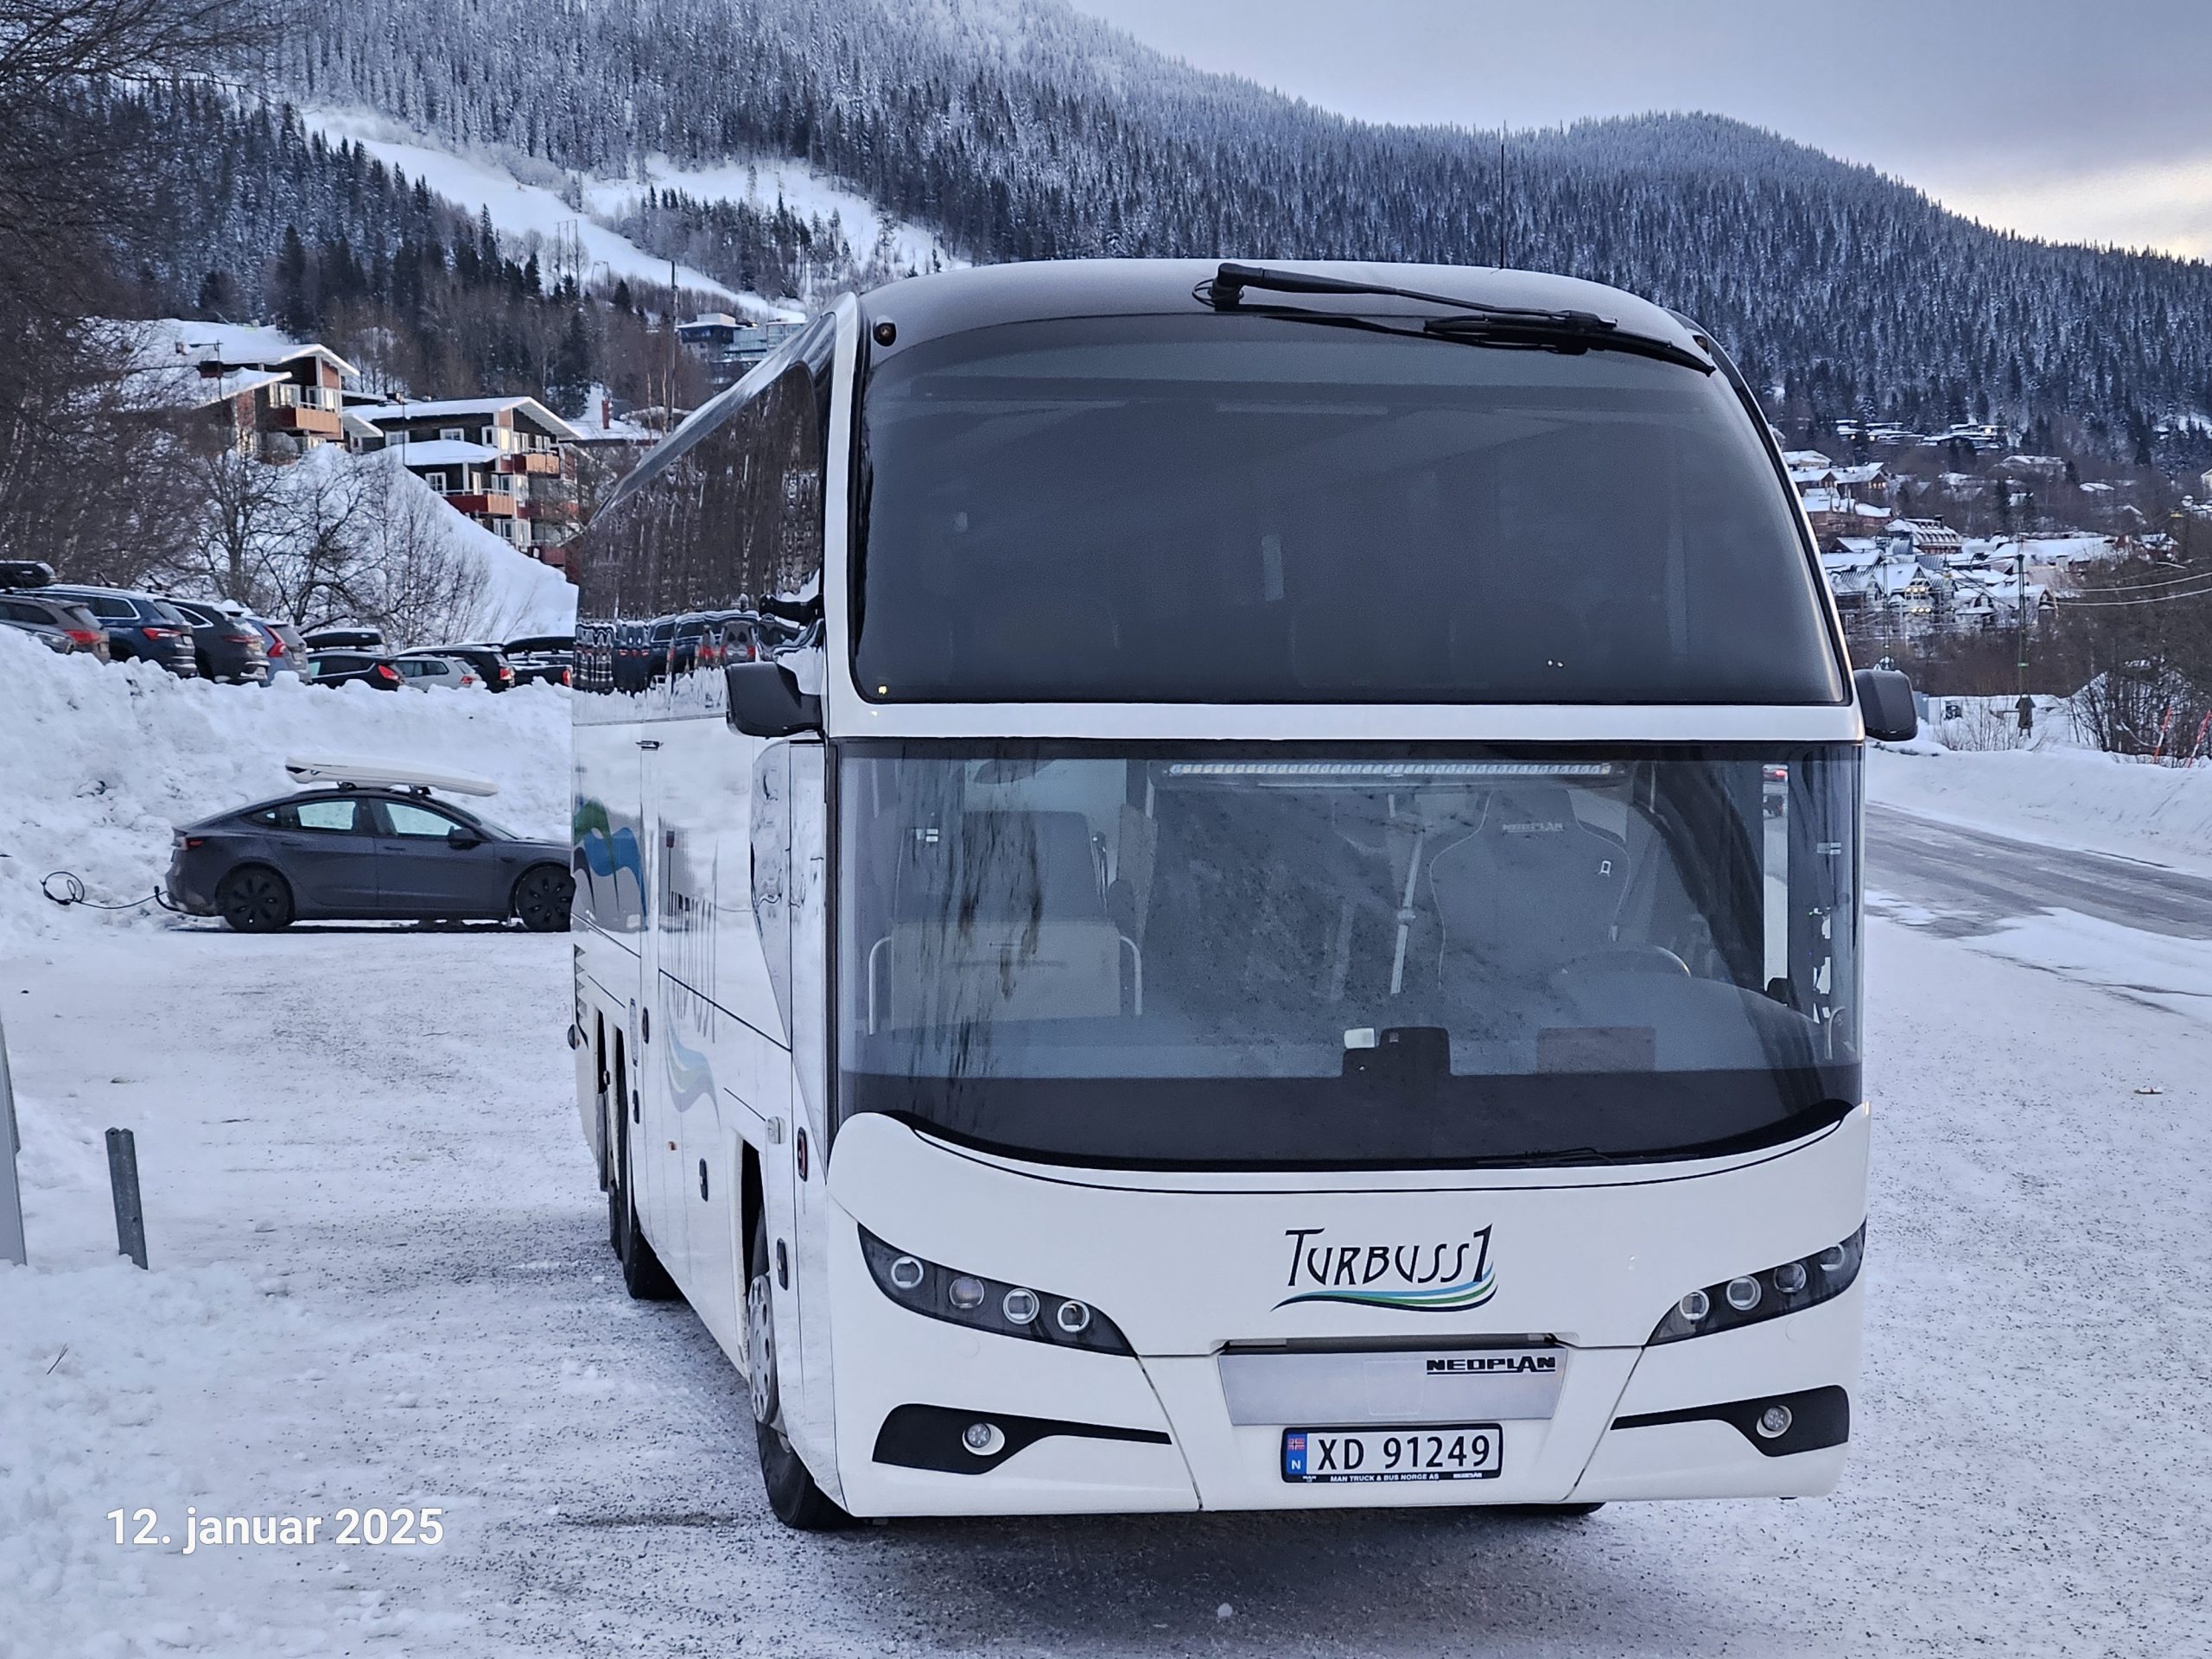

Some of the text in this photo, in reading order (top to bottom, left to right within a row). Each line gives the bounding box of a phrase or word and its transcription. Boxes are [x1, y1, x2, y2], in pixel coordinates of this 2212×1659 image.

[1285, 1223, 1494, 1287] TURBUSS1
[1427, 1356, 1556, 1375] NEOPLAN
[1291, 1459, 1301, 1470] N
[1318, 1434, 1490, 1470] XD 91249
